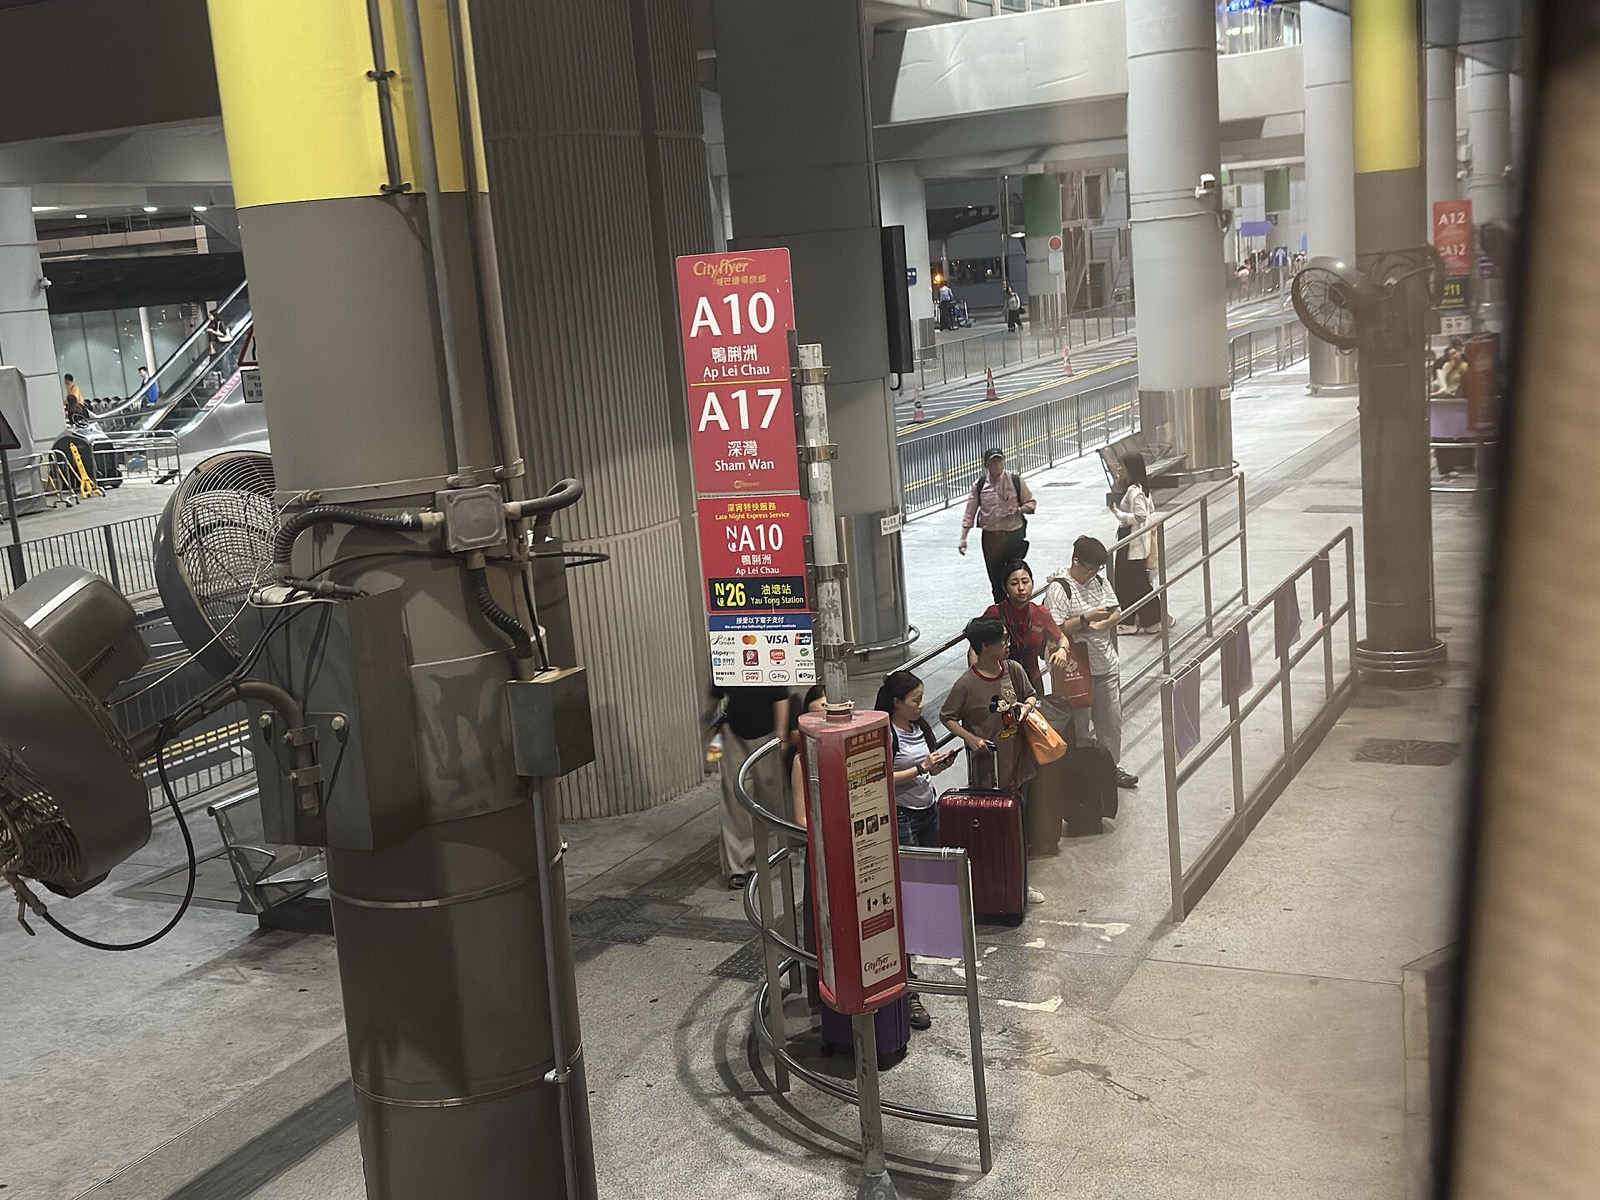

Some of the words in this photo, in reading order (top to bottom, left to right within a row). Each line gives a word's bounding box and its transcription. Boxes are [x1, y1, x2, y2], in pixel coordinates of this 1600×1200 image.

[1438, 212, 1467, 226] A12
[689, 291, 775, 338] A10
[703, 366, 719, 381] Ap
[721, 364, 738, 377] Lei
[741, 364, 770, 376] Chau
[697, 387, 782, 432] A17
[727, 439, 758, 458] 深灣
[714, 460, 746, 472] Sham
[748, 458, 775, 470] Wan
[715, 513, 728, 521] Late
[728, 512, 745, 521] Night
[746, 512, 768, 520] Express
[735, 567, 747, 577] Ap
[747, 566, 759, 575] Lei
[760, 566, 780, 574] Chau
[714, 582, 747, 607] N26
[760, 584, 792, 595] 油塘站
[750, 597, 763, 605] Yau
[763, 596, 780, 606] Tong
[781, 595, 804, 604] Station
[764, 634, 789, 644] VISA
[803, 672, 814, 680] Pay
